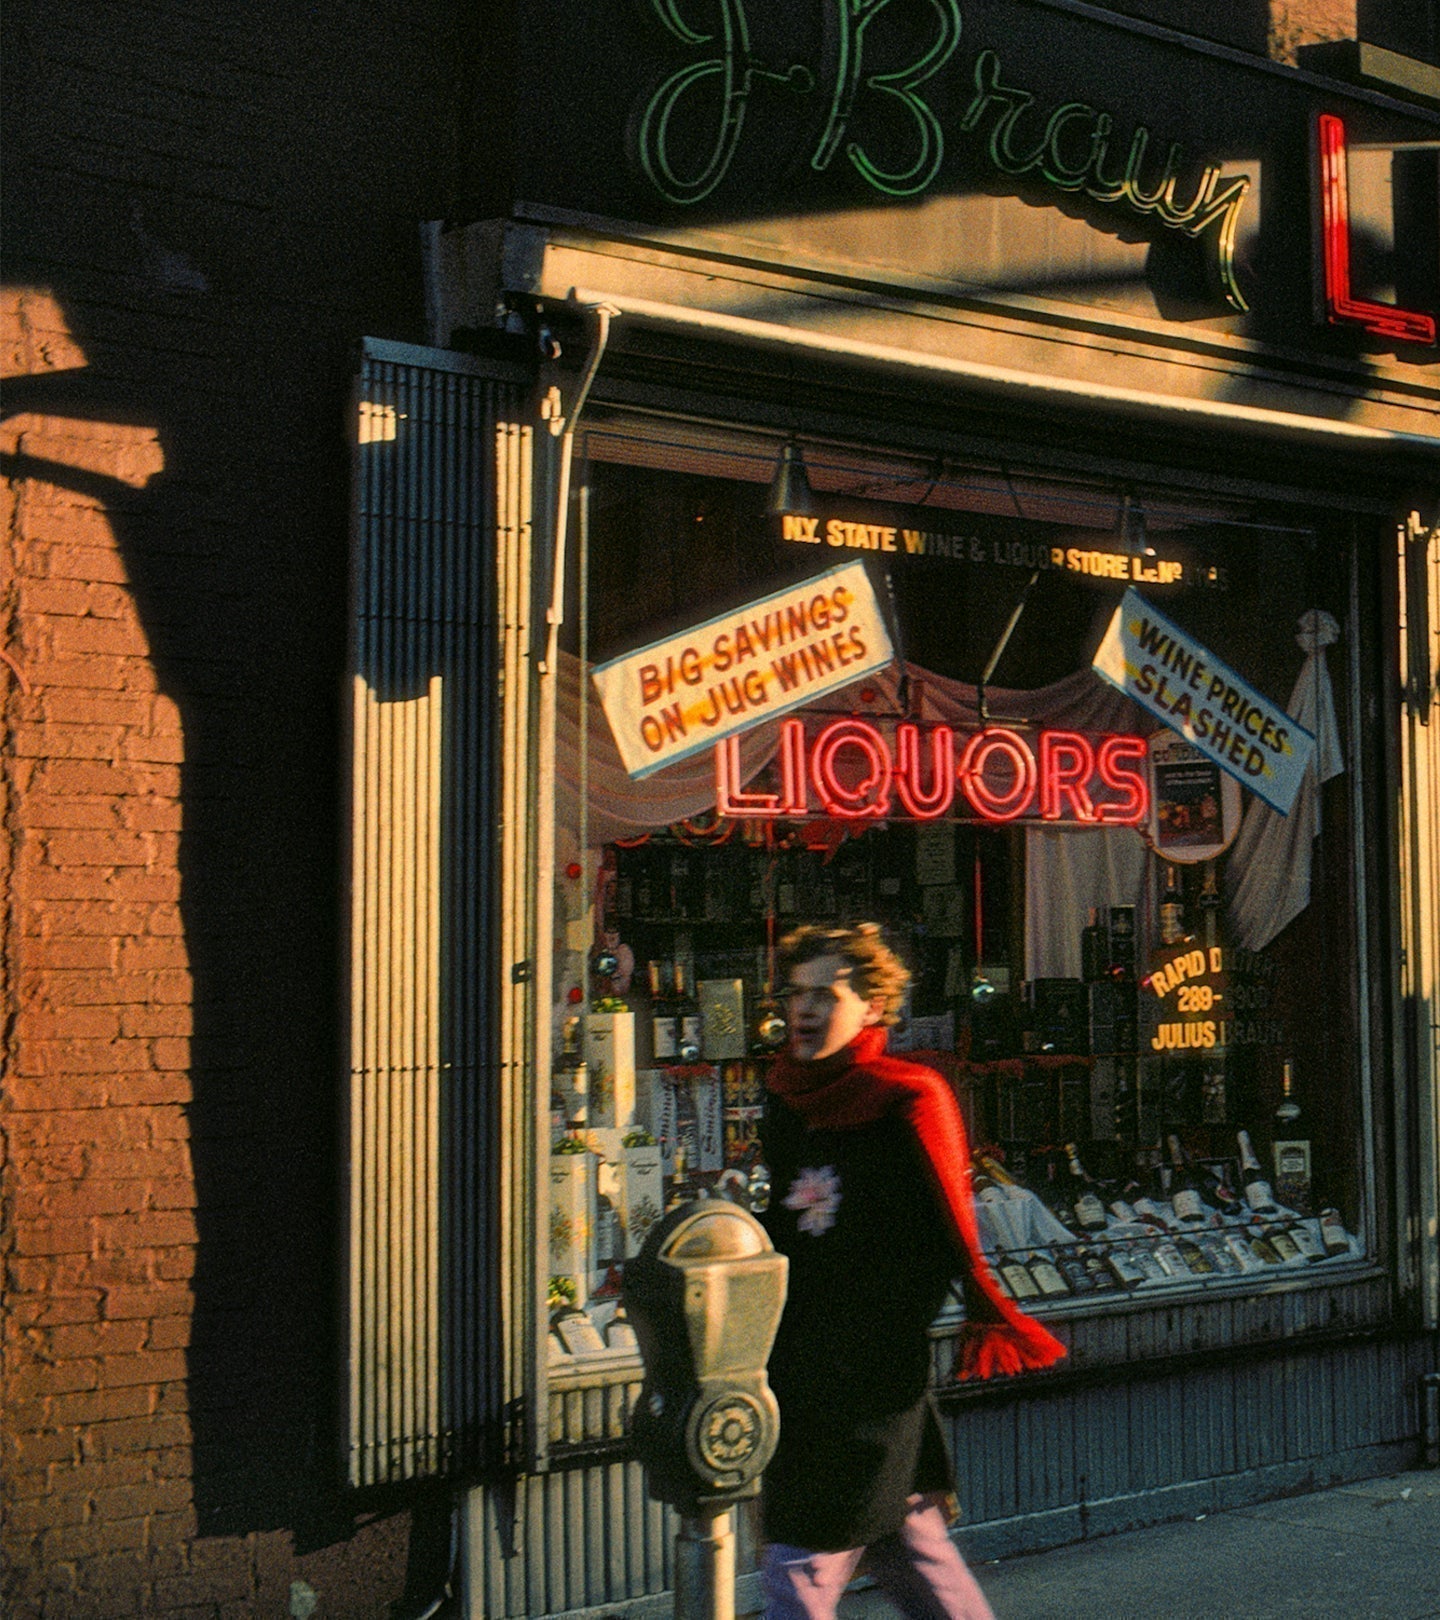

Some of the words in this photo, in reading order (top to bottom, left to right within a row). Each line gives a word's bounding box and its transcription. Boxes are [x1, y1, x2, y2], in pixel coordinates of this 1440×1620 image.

[826, 519, 898, 552] STATE
[902, 528, 965, 559] WINE
[1066, 548, 1130, 580] STORE
[637, 647, 703, 706] BIG
[713, 586, 850, 672] SAVINGS
[640, 702, 688, 752] ON
[700, 669, 770, 727] JUG
[770, 626, 867, 692] WINES
[1136, 617, 1206, 691] WINE
[1207, 675, 1289, 755] PRICES
[714, 718, 1150, 827] LIQUORS
[1134, 664, 1266, 777] SLASHED
[1150, 949, 1206, 998] RAPID
[1151, 1020, 1217, 1050] JULIUS
